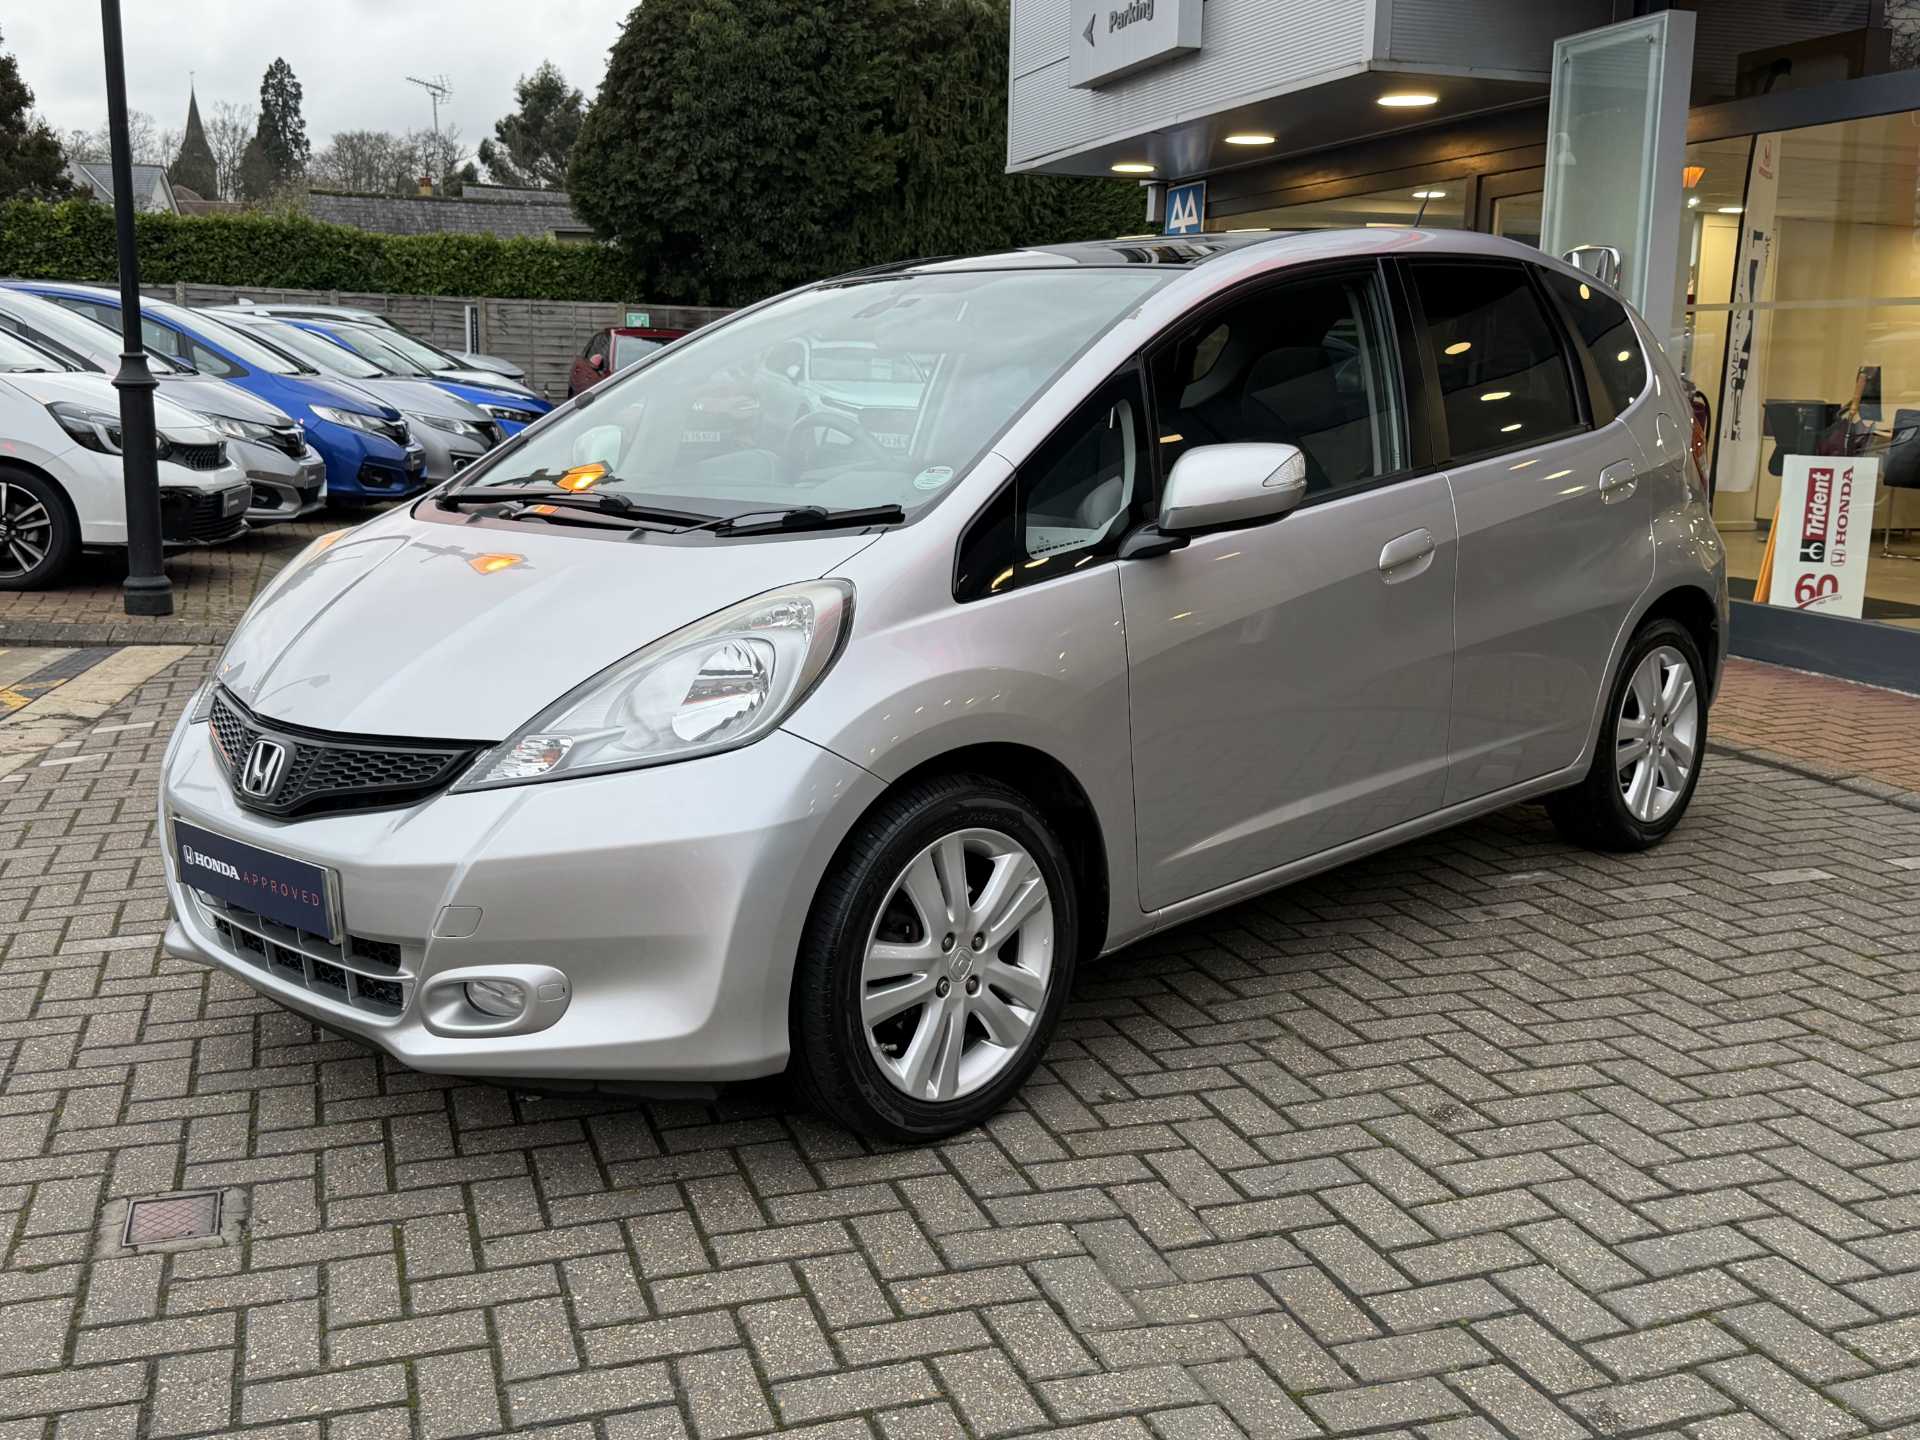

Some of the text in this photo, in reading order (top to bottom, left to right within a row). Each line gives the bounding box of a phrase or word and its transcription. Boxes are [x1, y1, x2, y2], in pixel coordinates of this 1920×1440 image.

[1109, 0, 1154, 34] Parking
[1806, 470, 1831, 537] Trident
[1834, 465, 1854, 546] HONDA
[1795, 573, 1839, 606] 60
[194, 853, 240, 881] HONDA
[243, 871, 320, 906] APPROVED
